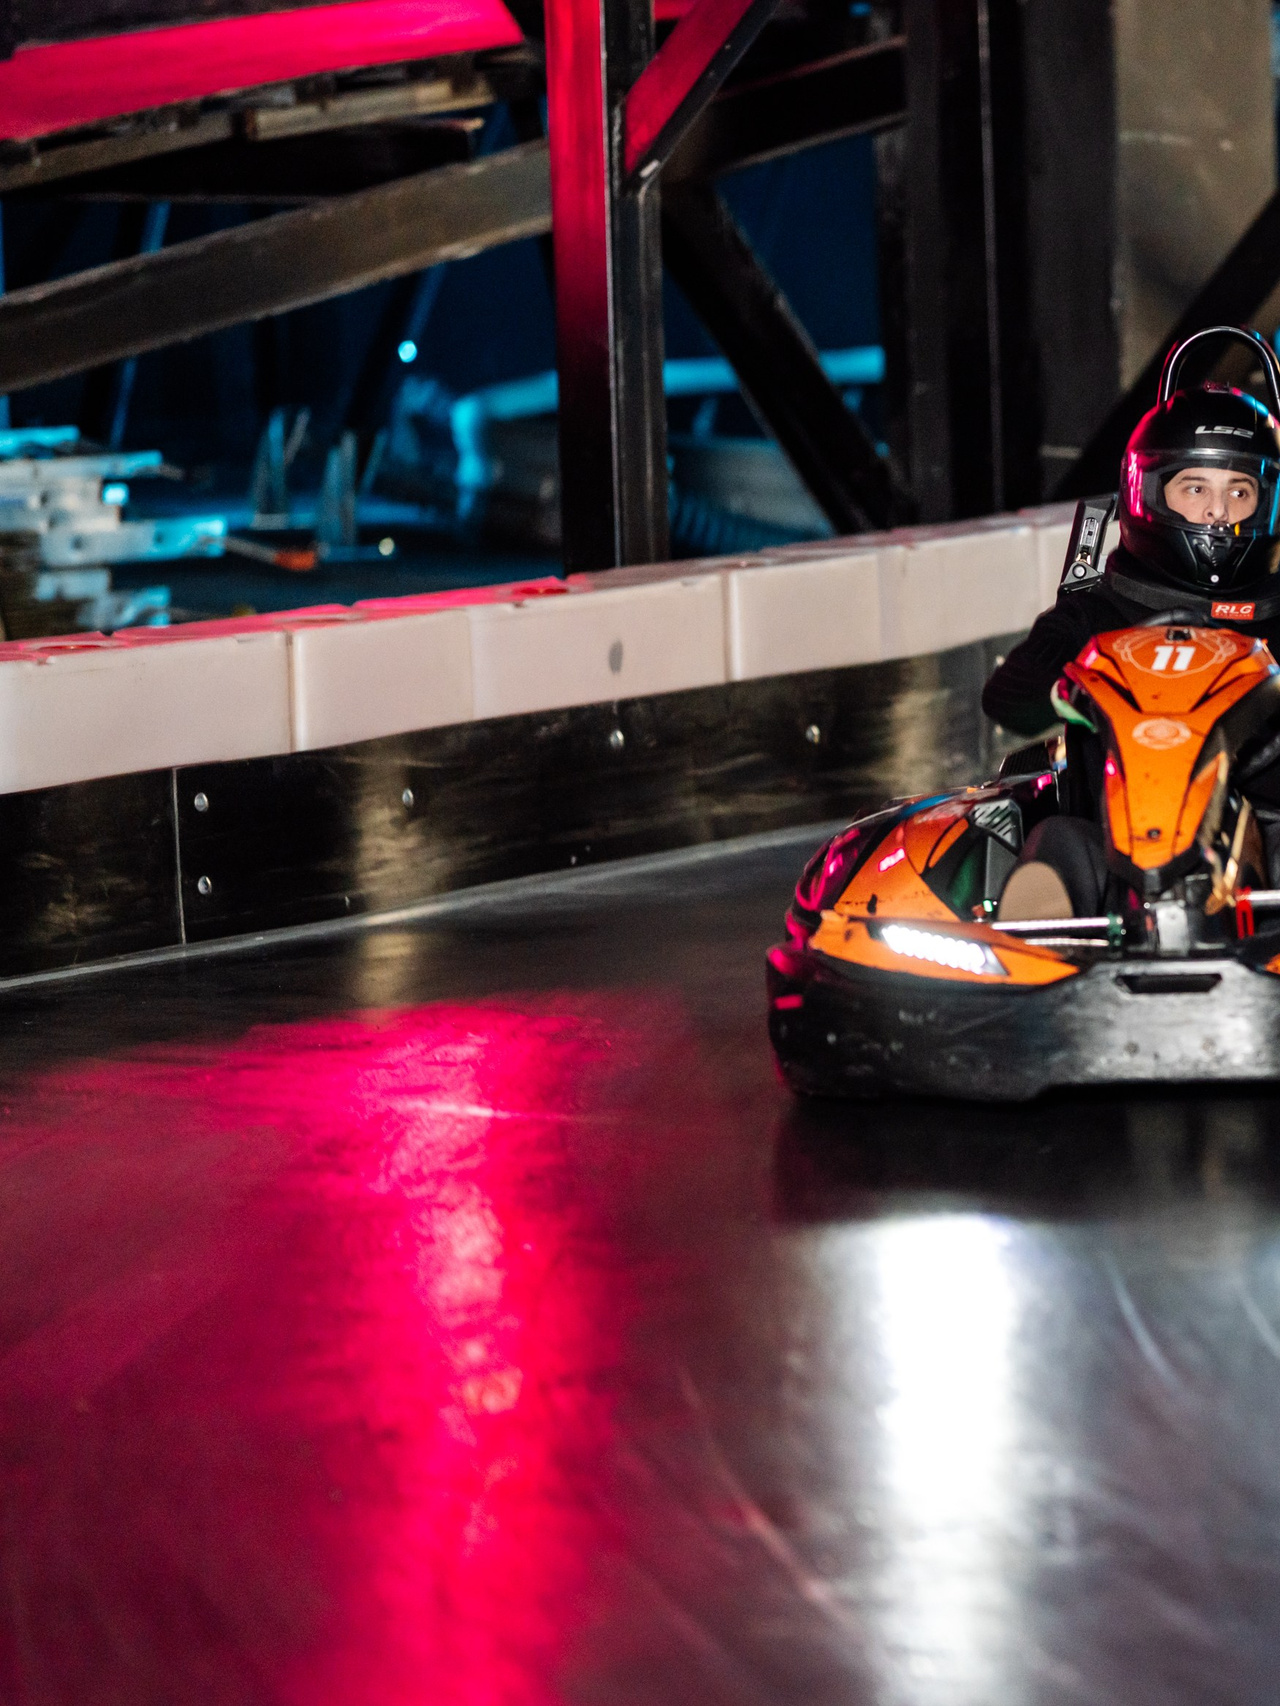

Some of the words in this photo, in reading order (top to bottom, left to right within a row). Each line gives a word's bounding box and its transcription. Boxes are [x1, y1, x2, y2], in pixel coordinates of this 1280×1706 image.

[1195, 425, 1254, 438] LS2
[1215, 604, 1252, 614] RLG
[1151, 645, 1196, 671] 11
